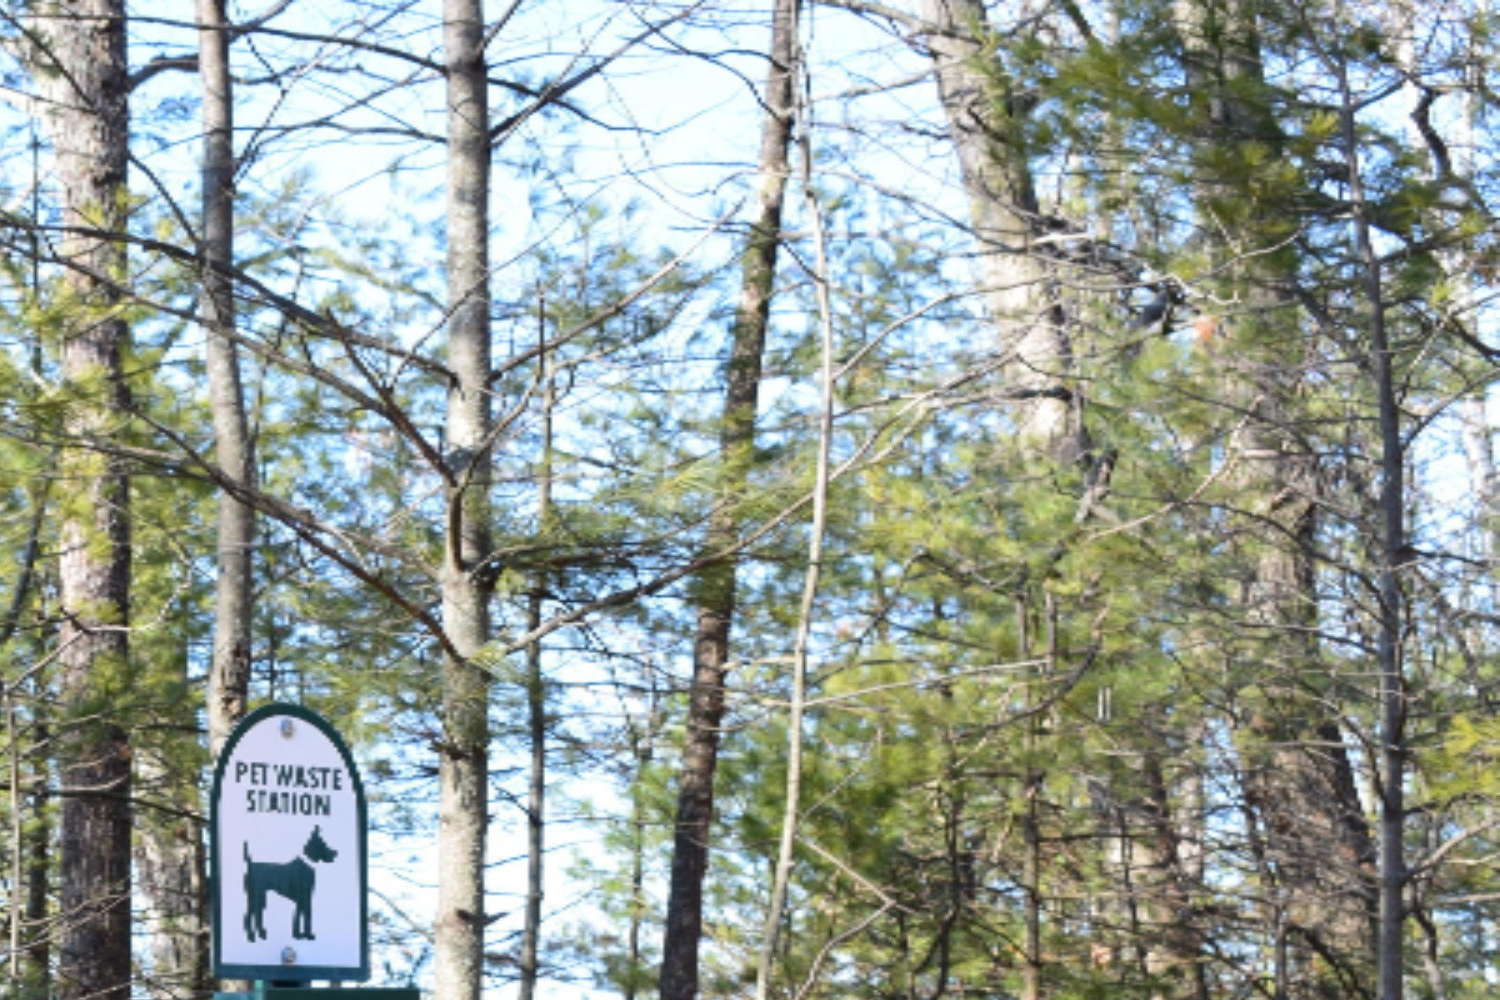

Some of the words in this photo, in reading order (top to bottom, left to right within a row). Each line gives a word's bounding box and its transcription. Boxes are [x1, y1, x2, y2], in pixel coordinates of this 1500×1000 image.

[235, 761, 269, 786] PET
[273, 764, 343, 791] WASTE
[246, 789, 331, 817] STATION
